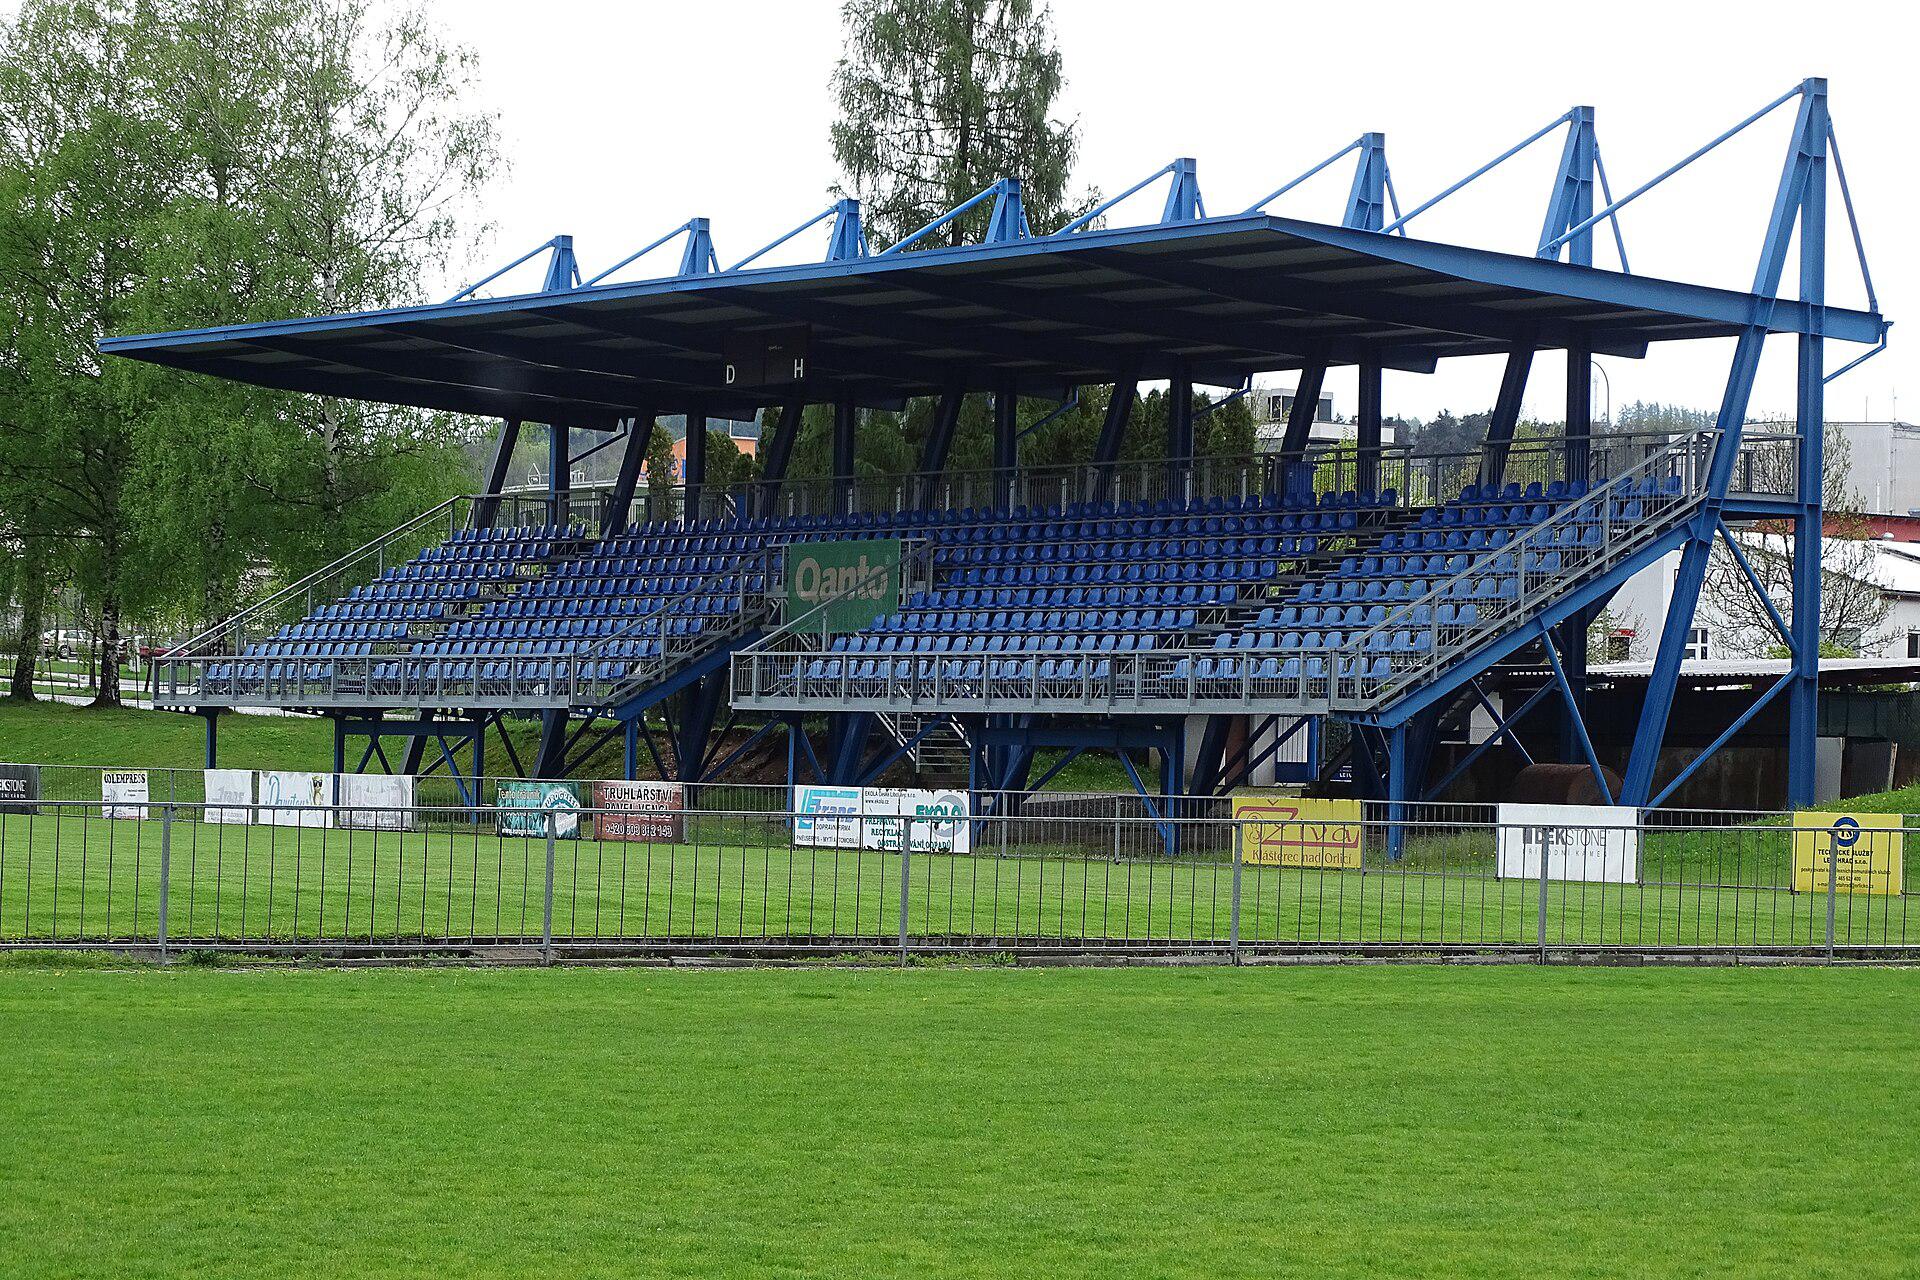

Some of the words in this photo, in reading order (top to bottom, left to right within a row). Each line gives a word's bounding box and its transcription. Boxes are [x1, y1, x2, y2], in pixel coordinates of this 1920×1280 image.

[726, 364, 736, 385] D
[794, 358, 804, 379] H
[796, 555, 888, 605] Qanto
[0, 779, 27, 792] KSTONE
[604, 786, 673, 802] TRUHLÁŘSTVÍ
[916, 804, 963, 825] EKOLA
[1252, 849, 1299, 862] Klášterec
[1302, 852, 1321, 863] nad
